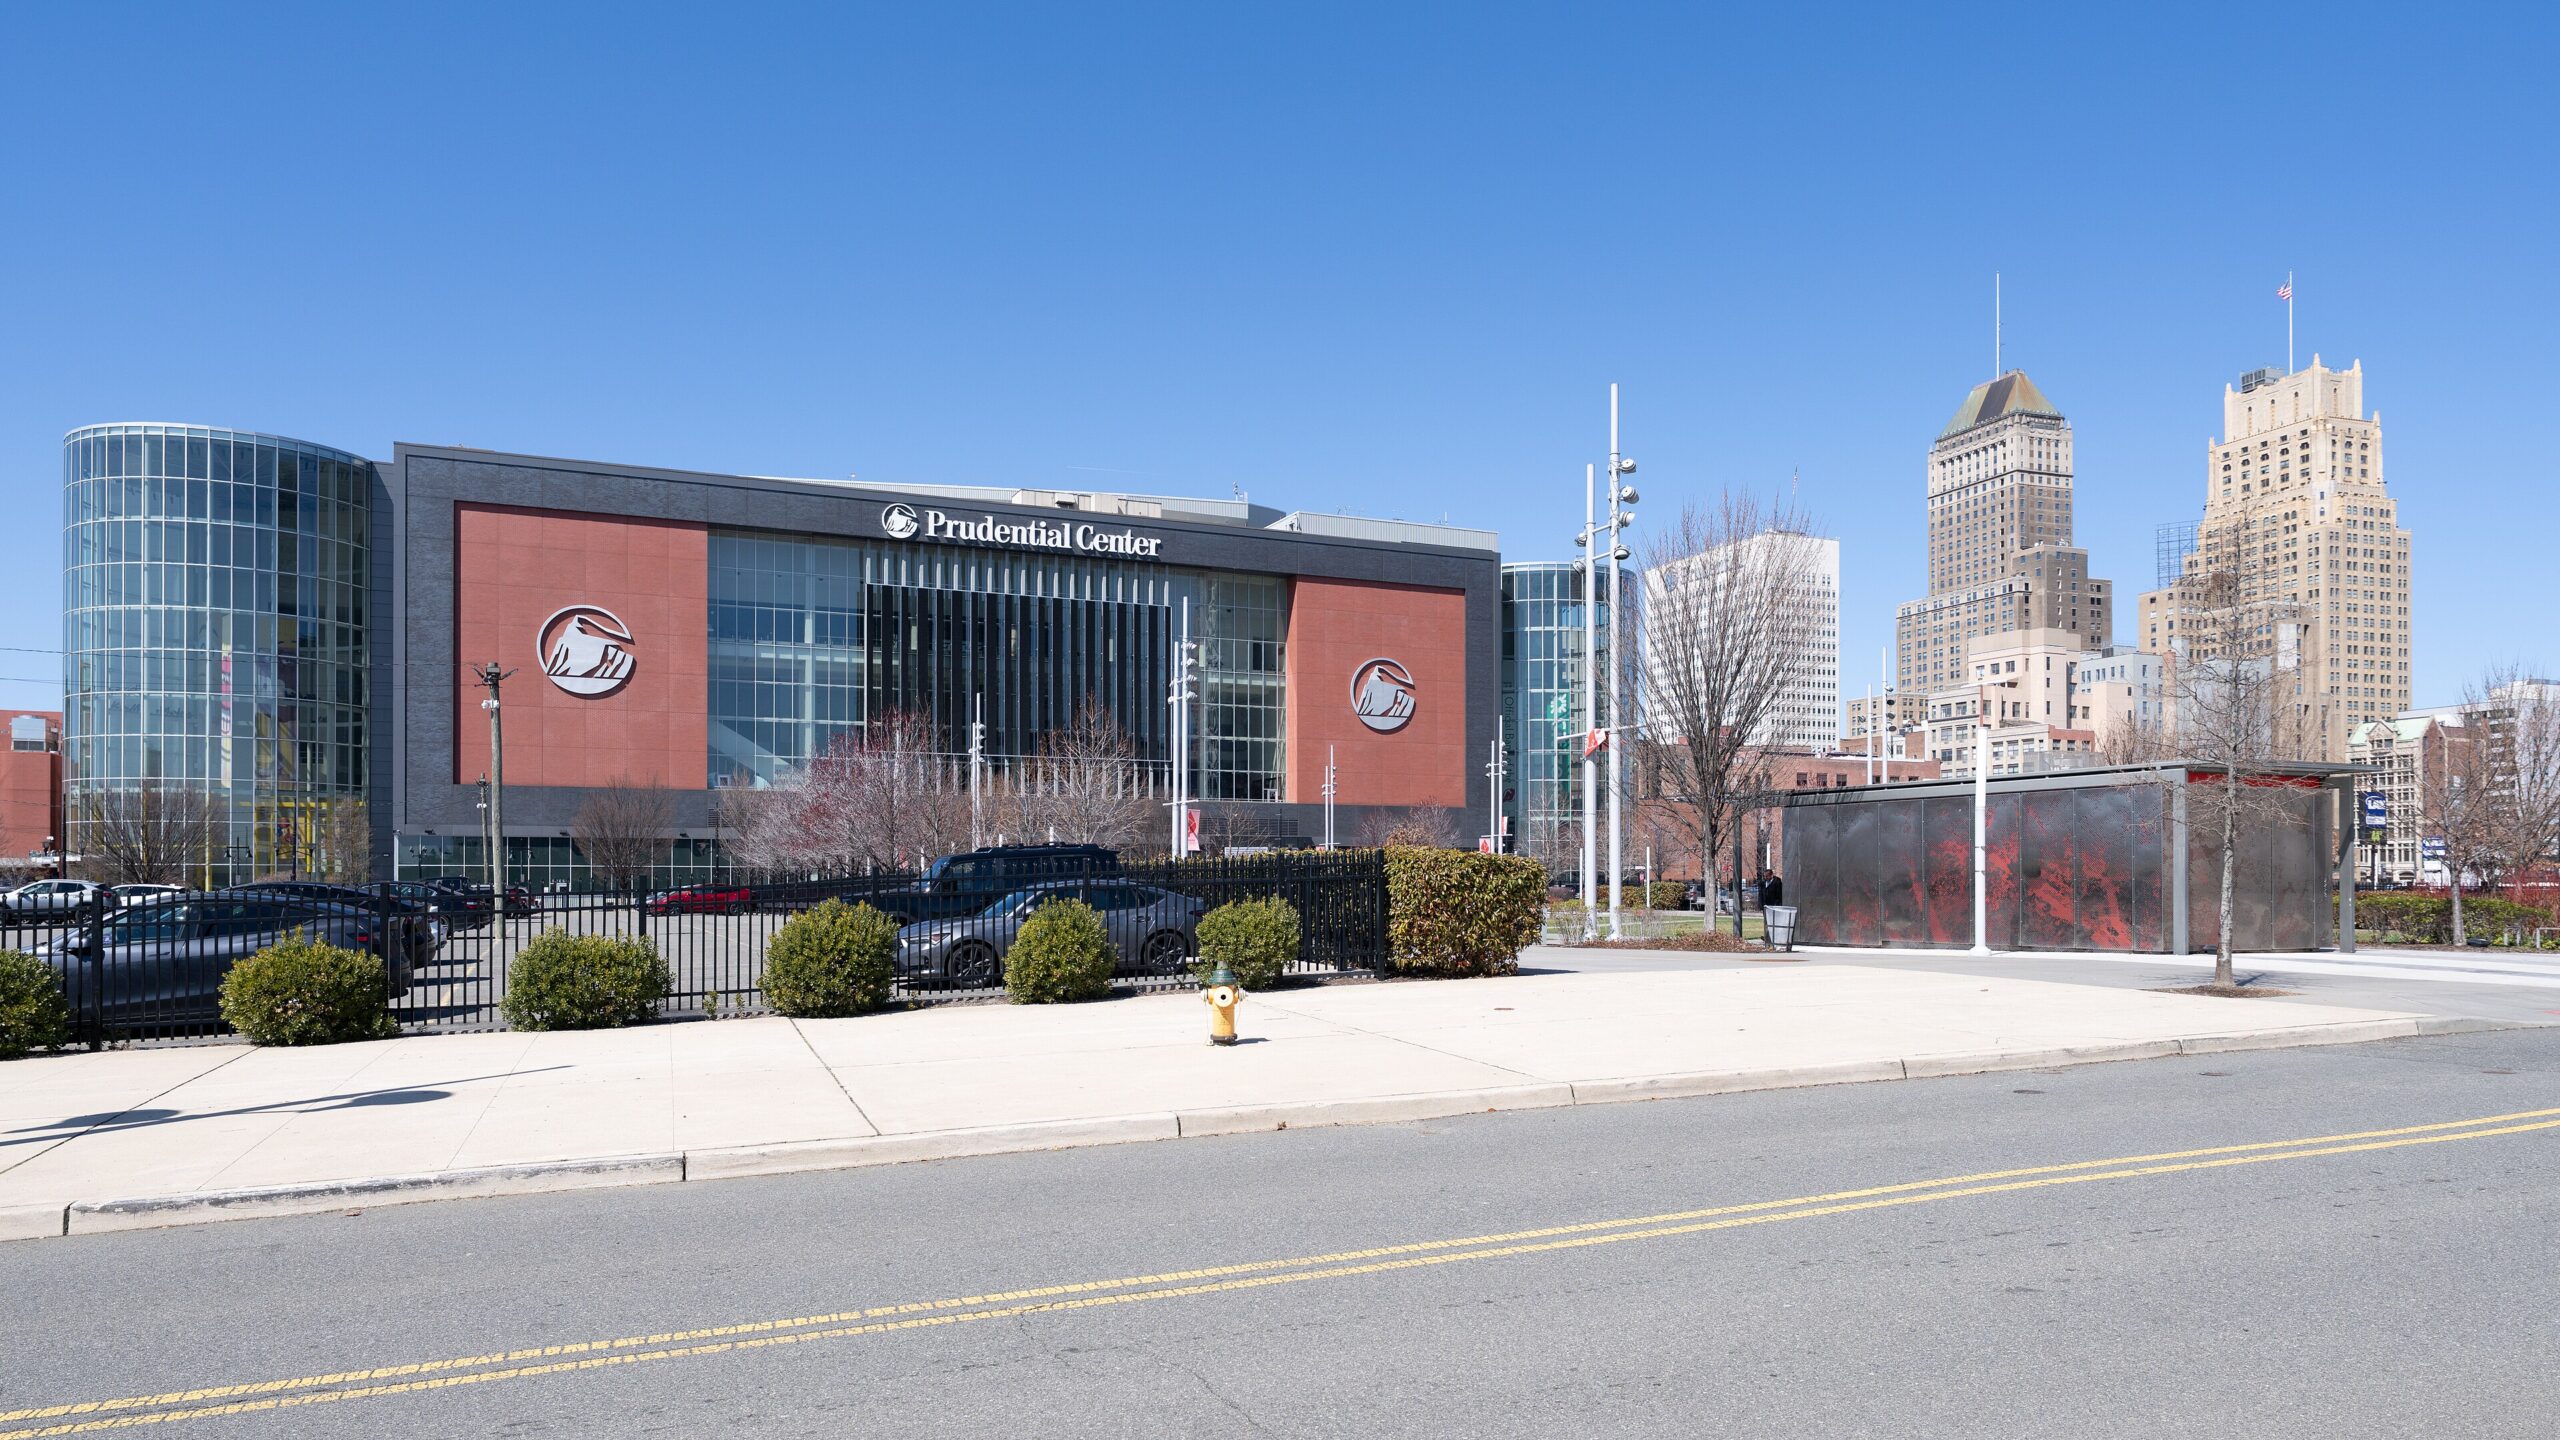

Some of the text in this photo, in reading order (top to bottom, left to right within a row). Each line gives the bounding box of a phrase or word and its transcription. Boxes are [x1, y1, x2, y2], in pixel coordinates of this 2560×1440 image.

[924, 510, 1161, 556] Prudential Center
[1504, 696, 1514, 731] Official
[1504, 733, 1514, 756] Ban
